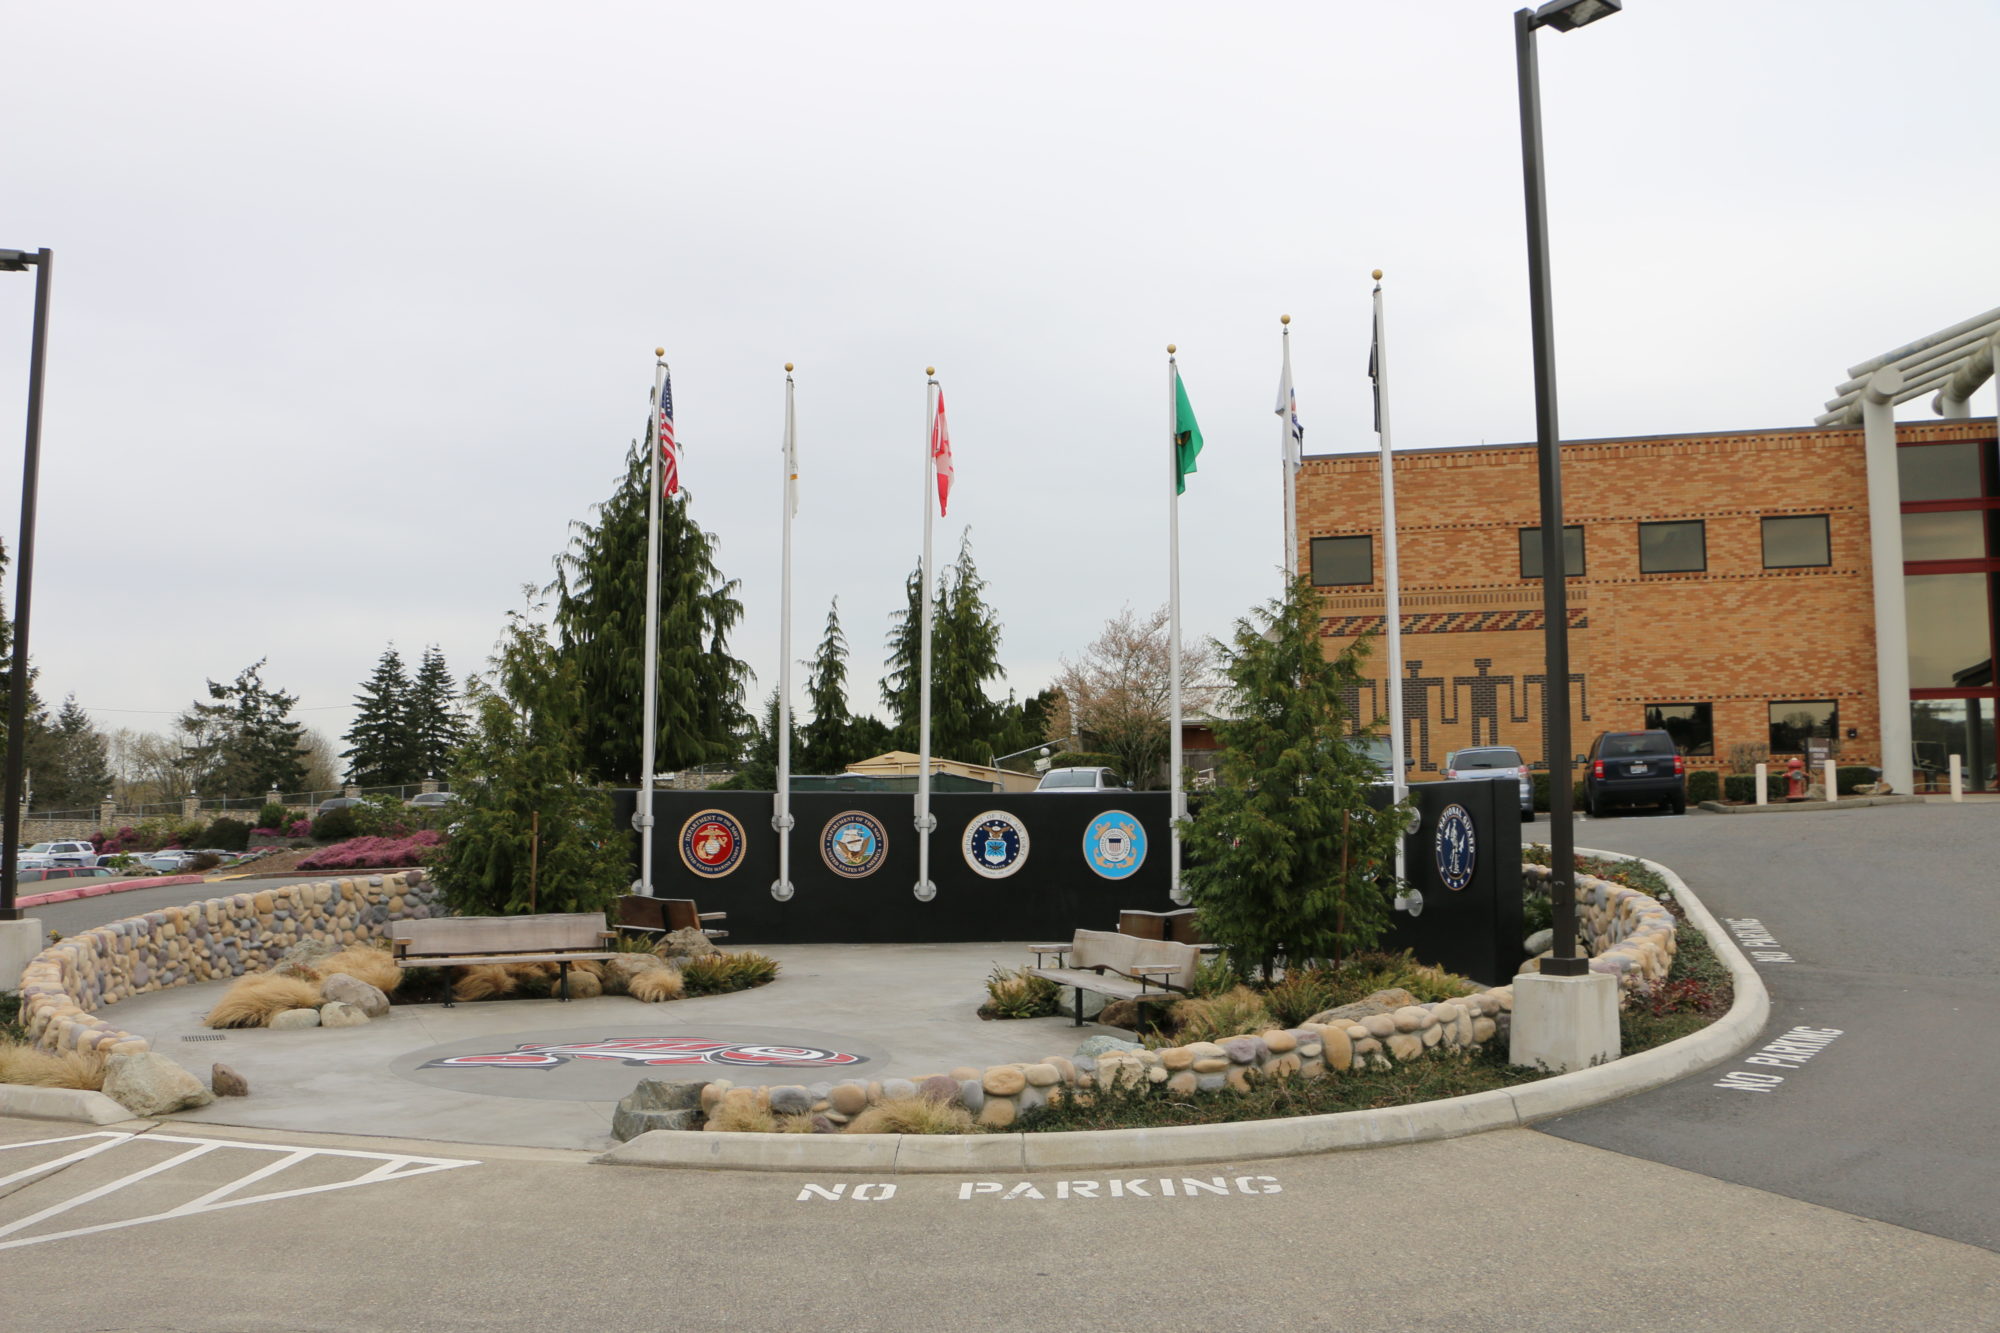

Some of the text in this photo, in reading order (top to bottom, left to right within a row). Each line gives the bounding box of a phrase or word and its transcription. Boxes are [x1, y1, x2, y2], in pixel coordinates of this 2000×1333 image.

[685, 815, 716, 841] DEPARTMENT
[730, 826, 740, 840] NAVY
[826, 816, 855, 840] DEPARTMENT
[864, 819, 875, 829] THE
[873, 827, 882, 840] NAVY
[1439, 806, 1462, 829] NATIONAL
[1463, 815, 1475, 853] GUARD
[826, 848, 840, 866] UNITED
[838, 864, 858, 873] STATES
[866, 848, 882, 868] AMERICA
[1725, 918, 1796, 963] NO PARKING
[1713, 1026, 1845, 1093] NO PARKING
[797, 1176, 1283, 1201] NO PARKING
